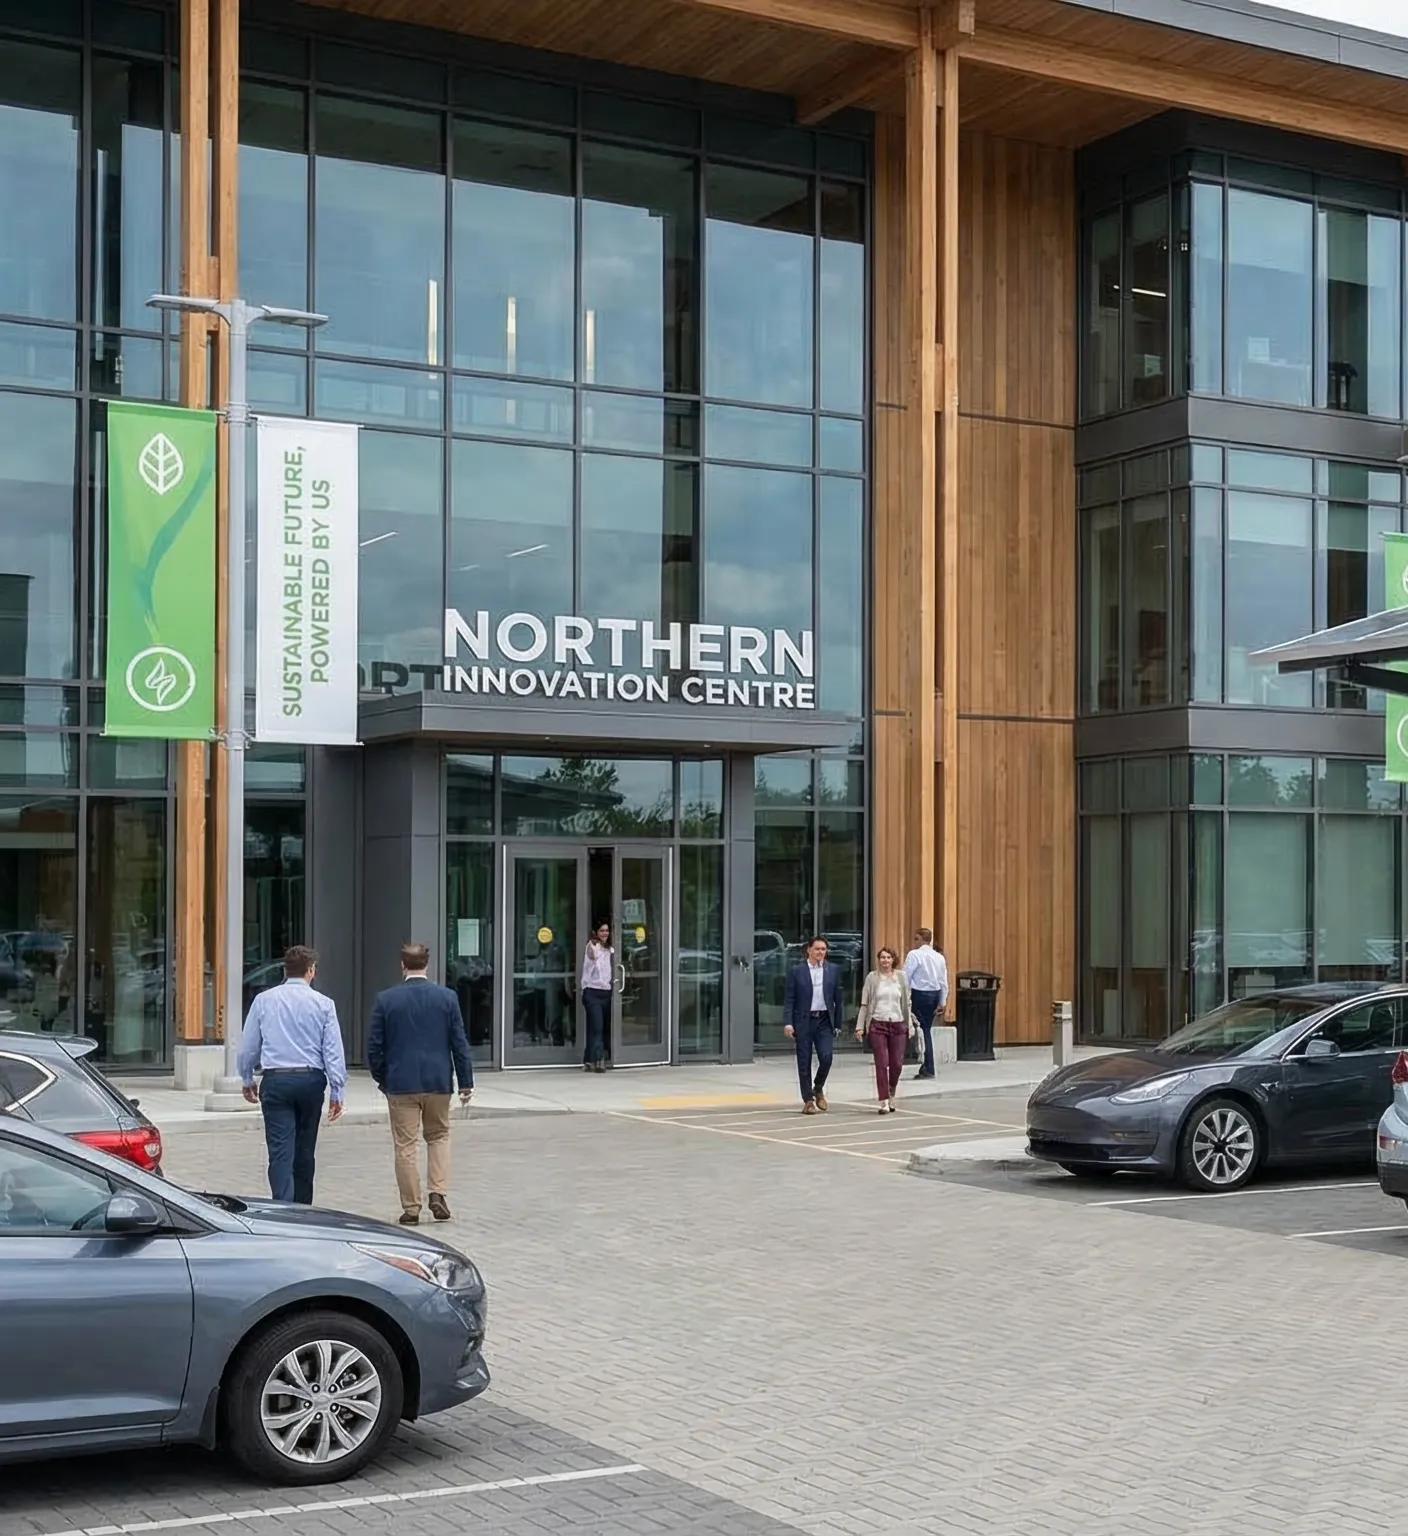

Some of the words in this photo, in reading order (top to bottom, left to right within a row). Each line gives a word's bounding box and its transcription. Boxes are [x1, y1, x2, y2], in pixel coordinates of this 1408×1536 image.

[284, 446, 306, 545] FUTURE,
[312, 479, 331, 509] US
[312, 518, 330, 549] BY
[283, 554, 302, 717] SUSTAINABLE
[310, 558, 330, 683] POWERED
[443, 607, 815, 678] NORTHERN
[443, 665, 669, 703] INNOVATION
[681, 676, 816, 710] CENTRE
